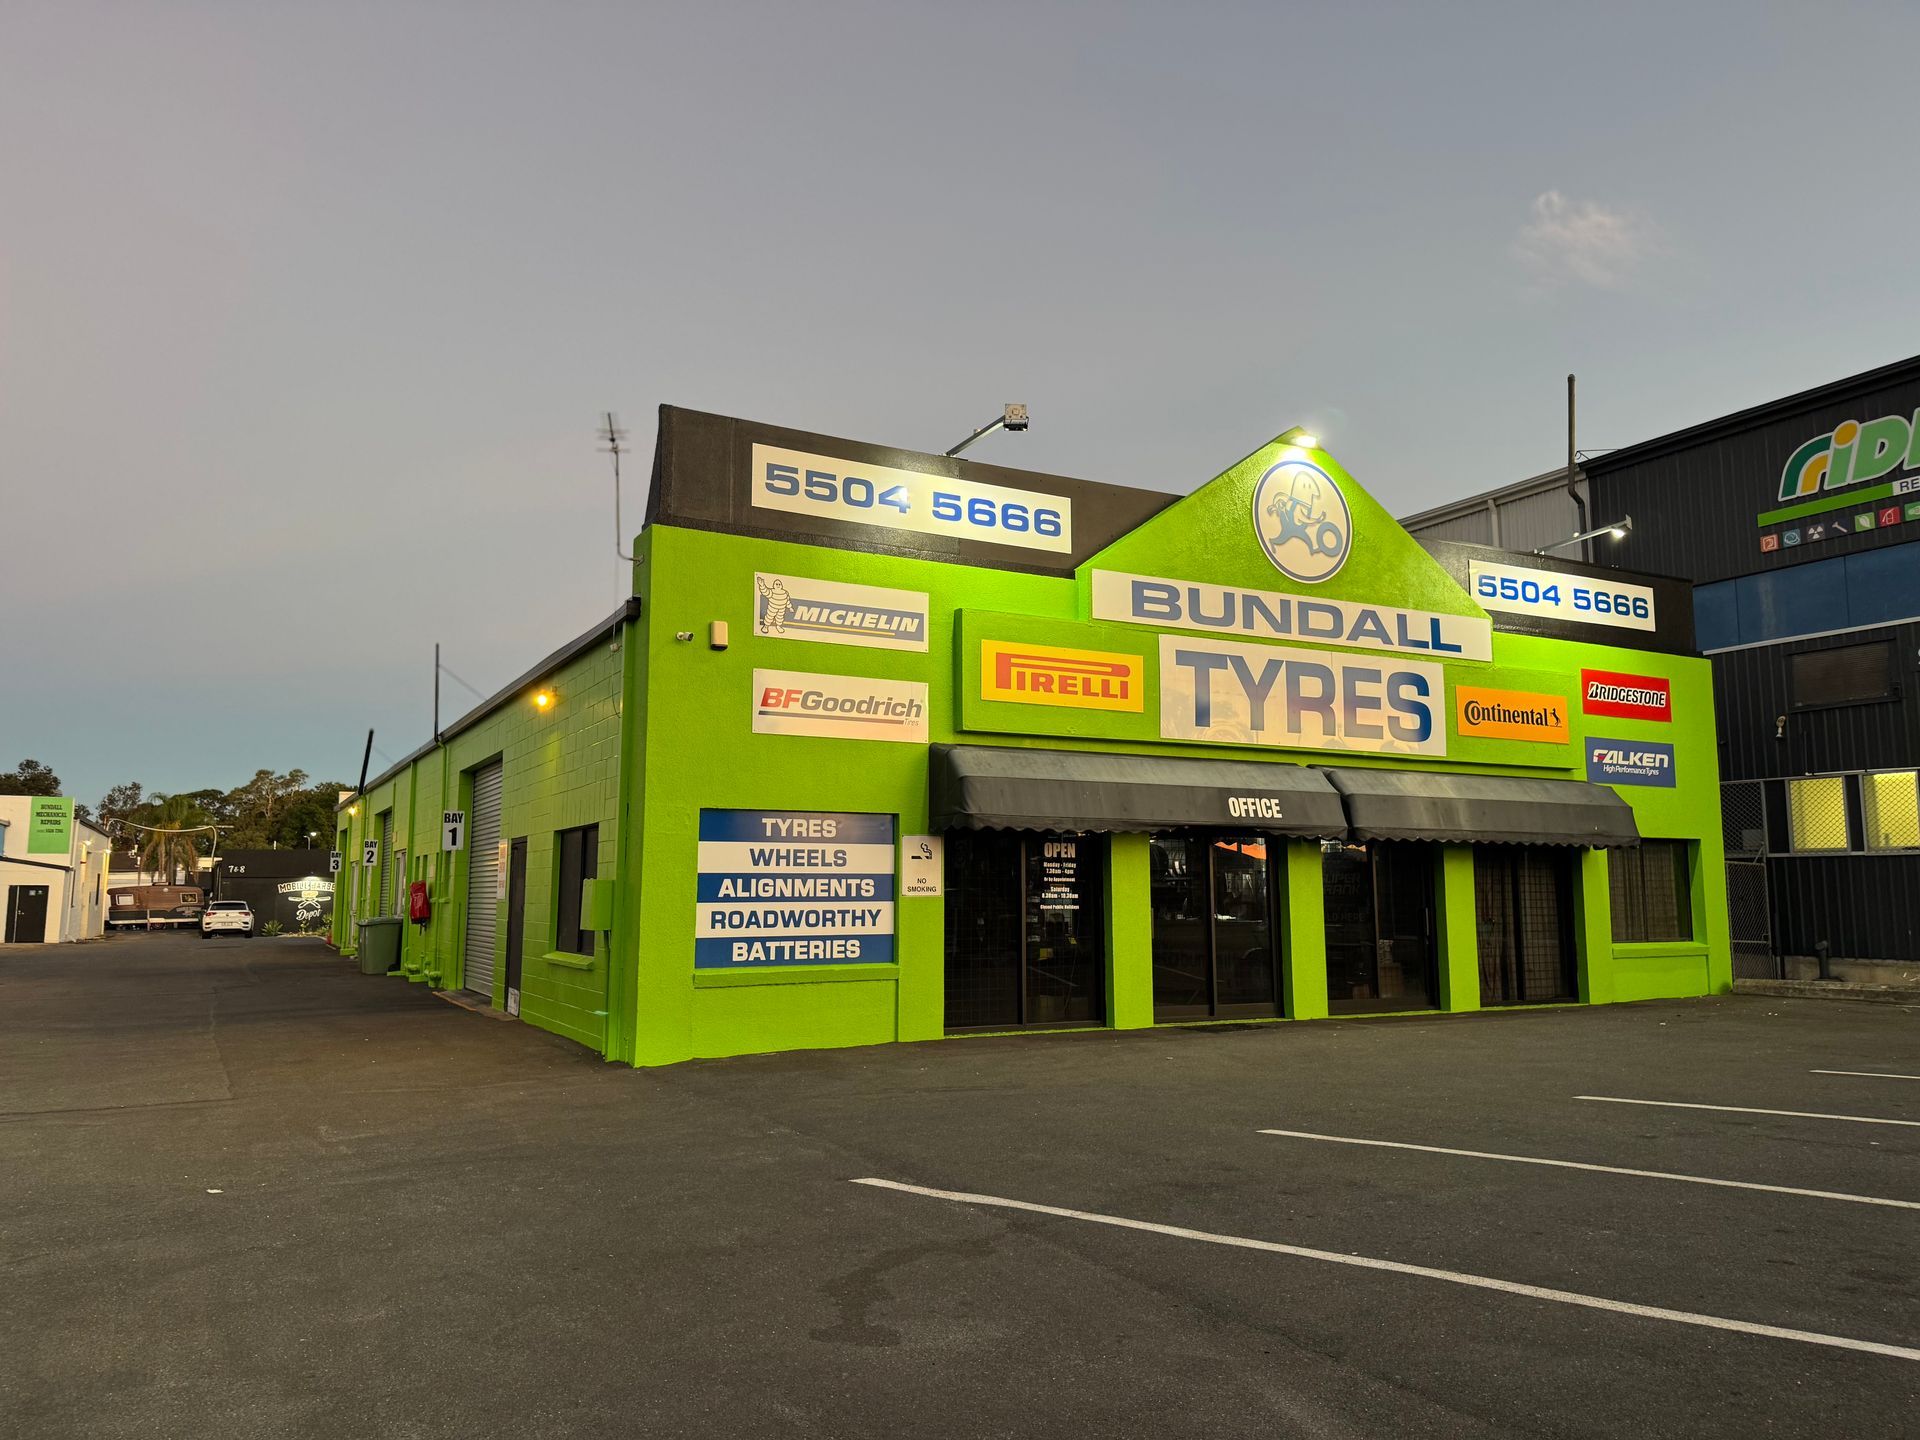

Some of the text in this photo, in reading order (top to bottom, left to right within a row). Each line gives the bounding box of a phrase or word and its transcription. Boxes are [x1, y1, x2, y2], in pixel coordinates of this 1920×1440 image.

[765, 461, 1062, 538] 5504 5666
[1477, 574, 1649, 619] 5504 5666
[793, 605, 920, 633] MICHELIN
[1131, 580, 1462, 653] BUNDALL
[995, 651, 1131, 700] PIRELLI
[760, 687, 922, 718] BFGoodrich
[1175, 649, 1432, 743] TYRES
[1587, 682, 1666, 707] BRIDGESTONE
[904, 718, 919, 727] Tires
[1464, 700, 1549, 727] Continental
[1593, 749, 1669, 768] FALKEN
[1603, 764, 1659, 777] High Performance Tyres
[1228, 796, 1282, 818] OFFICE
[444, 813, 464, 823] BAY
[762, 818, 837, 838] TYRES
[364, 840, 377, 848] BAY
[448, 827, 458, 846] 1
[366, 850, 374, 863] 2
[749, 848, 847, 867] WHEELS
[1044, 842, 1076, 858] OPEN
[332, 859, 339, 870] 3
[718, 878, 875, 898] ALIGNMENTS
[710, 909, 882, 929] ROADWORTHY
[732, 939, 861, 962] BATTERIES
